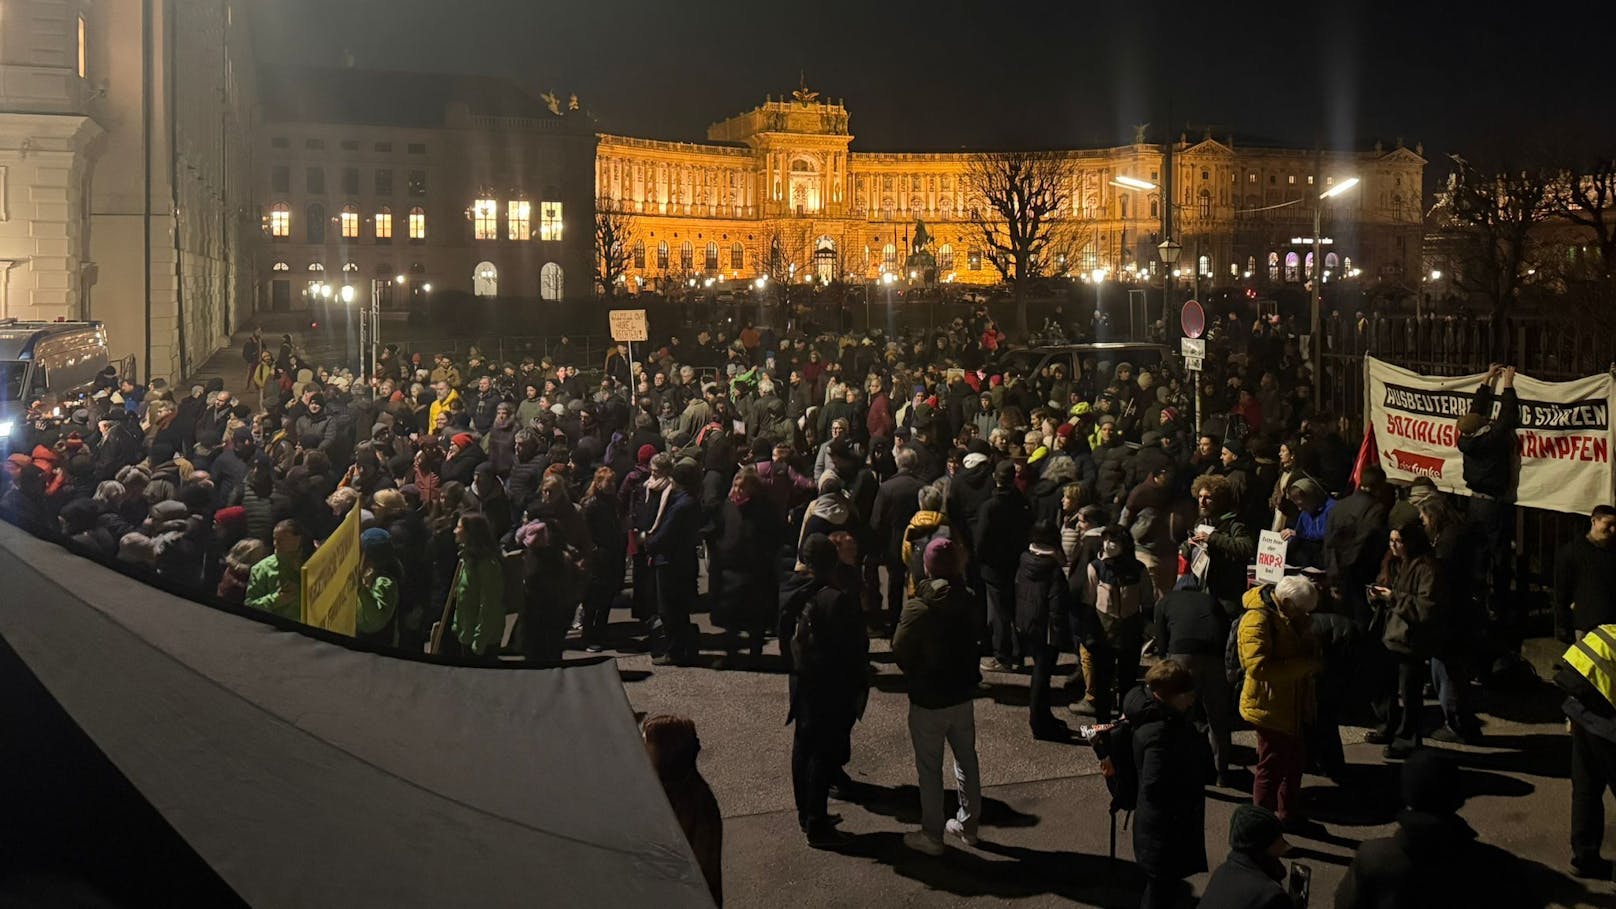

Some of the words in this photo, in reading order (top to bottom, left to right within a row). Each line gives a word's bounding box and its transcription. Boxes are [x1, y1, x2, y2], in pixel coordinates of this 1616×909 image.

[1535, 404, 1606, 426] STÜRZEN
[1387, 414, 1459, 447] SOZIALIS
[1411, 463, 1440, 479] funke
[1259, 553, 1274, 565] RKP
